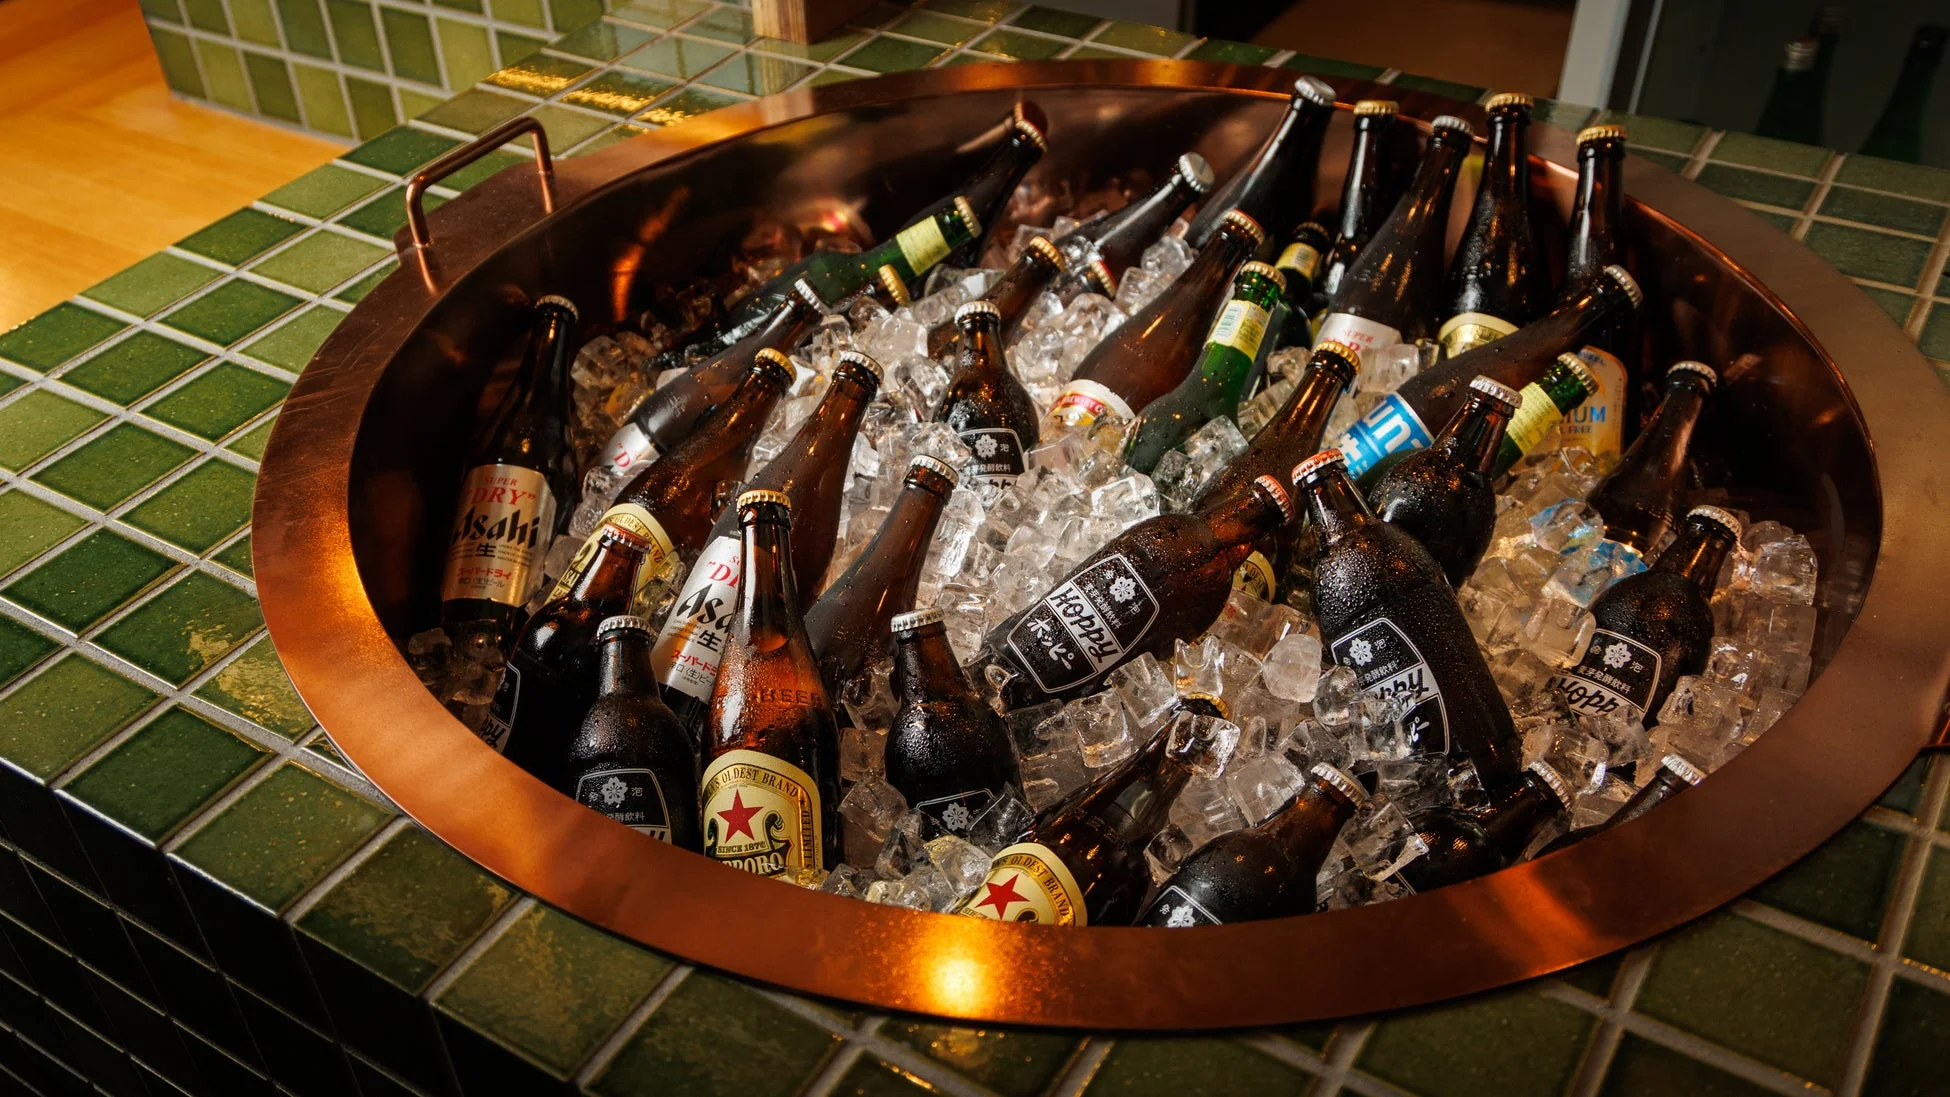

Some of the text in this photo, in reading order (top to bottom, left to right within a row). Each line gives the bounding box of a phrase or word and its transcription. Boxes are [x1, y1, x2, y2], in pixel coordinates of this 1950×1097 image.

[452, 506, 541, 549] Asahi
[475, 543, 496, 558] 生
[696, 630, 723, 652] 生
[1358, 661, 1400, 687] 芽発酵飲料
[721, 767, 760, 784] OLDEST
[761, 771, 799, 798] BRAND
[717, 844, 743, 854] SINCE
[1010, 855, 1071, 917] OLDEST BRAND
